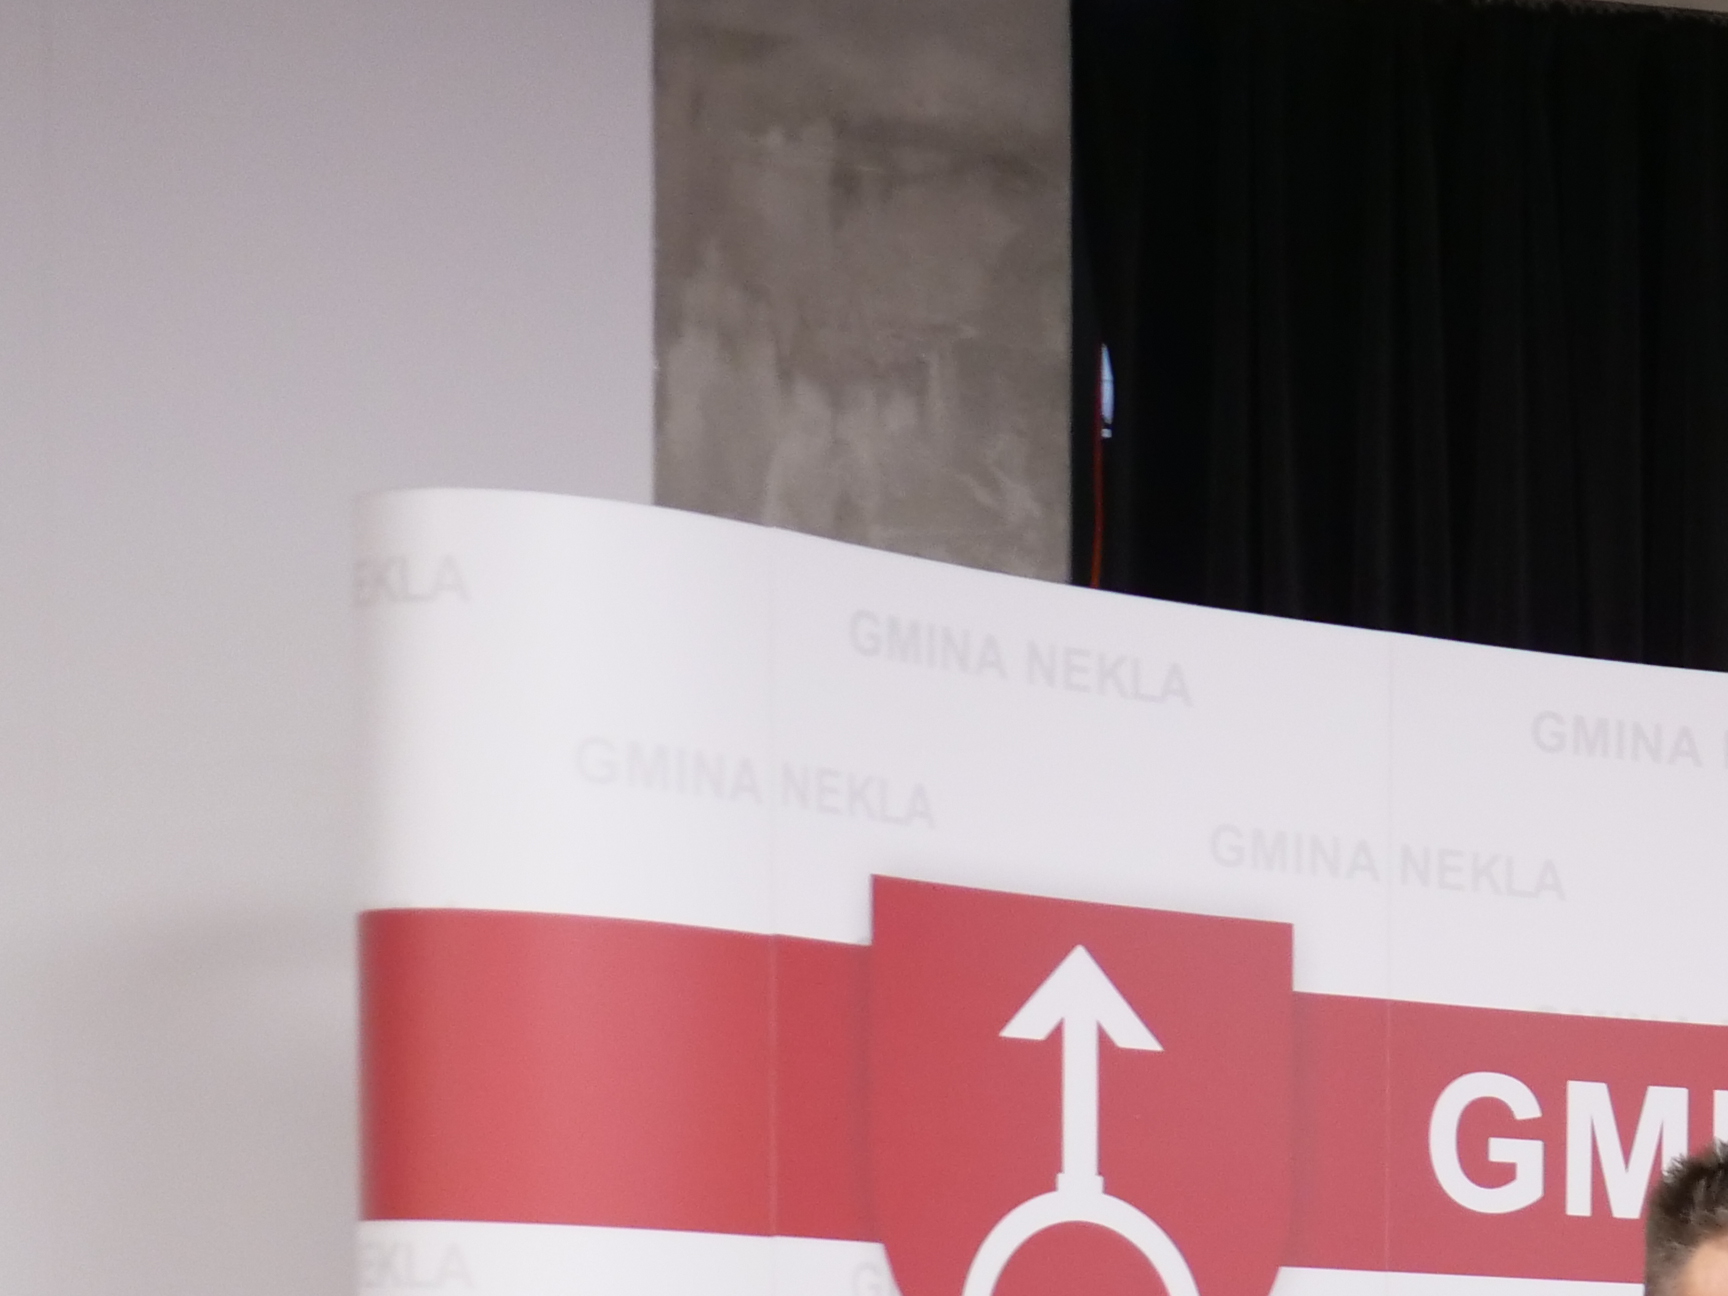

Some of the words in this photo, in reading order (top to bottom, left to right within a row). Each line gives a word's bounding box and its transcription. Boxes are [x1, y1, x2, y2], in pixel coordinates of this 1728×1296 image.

[848, 608, 1008, 680] GMINA
[1026, 640, 1194, 708] NEKLA
[1531, 710, 1703, 768] GMINA
[576, 736, 762, 803] GMINA
[782, 762, 936, 829] NEKLA
[1209, 823, 1380, 882] GMINA
[1400, 844, 1566, 901] NEKLA
